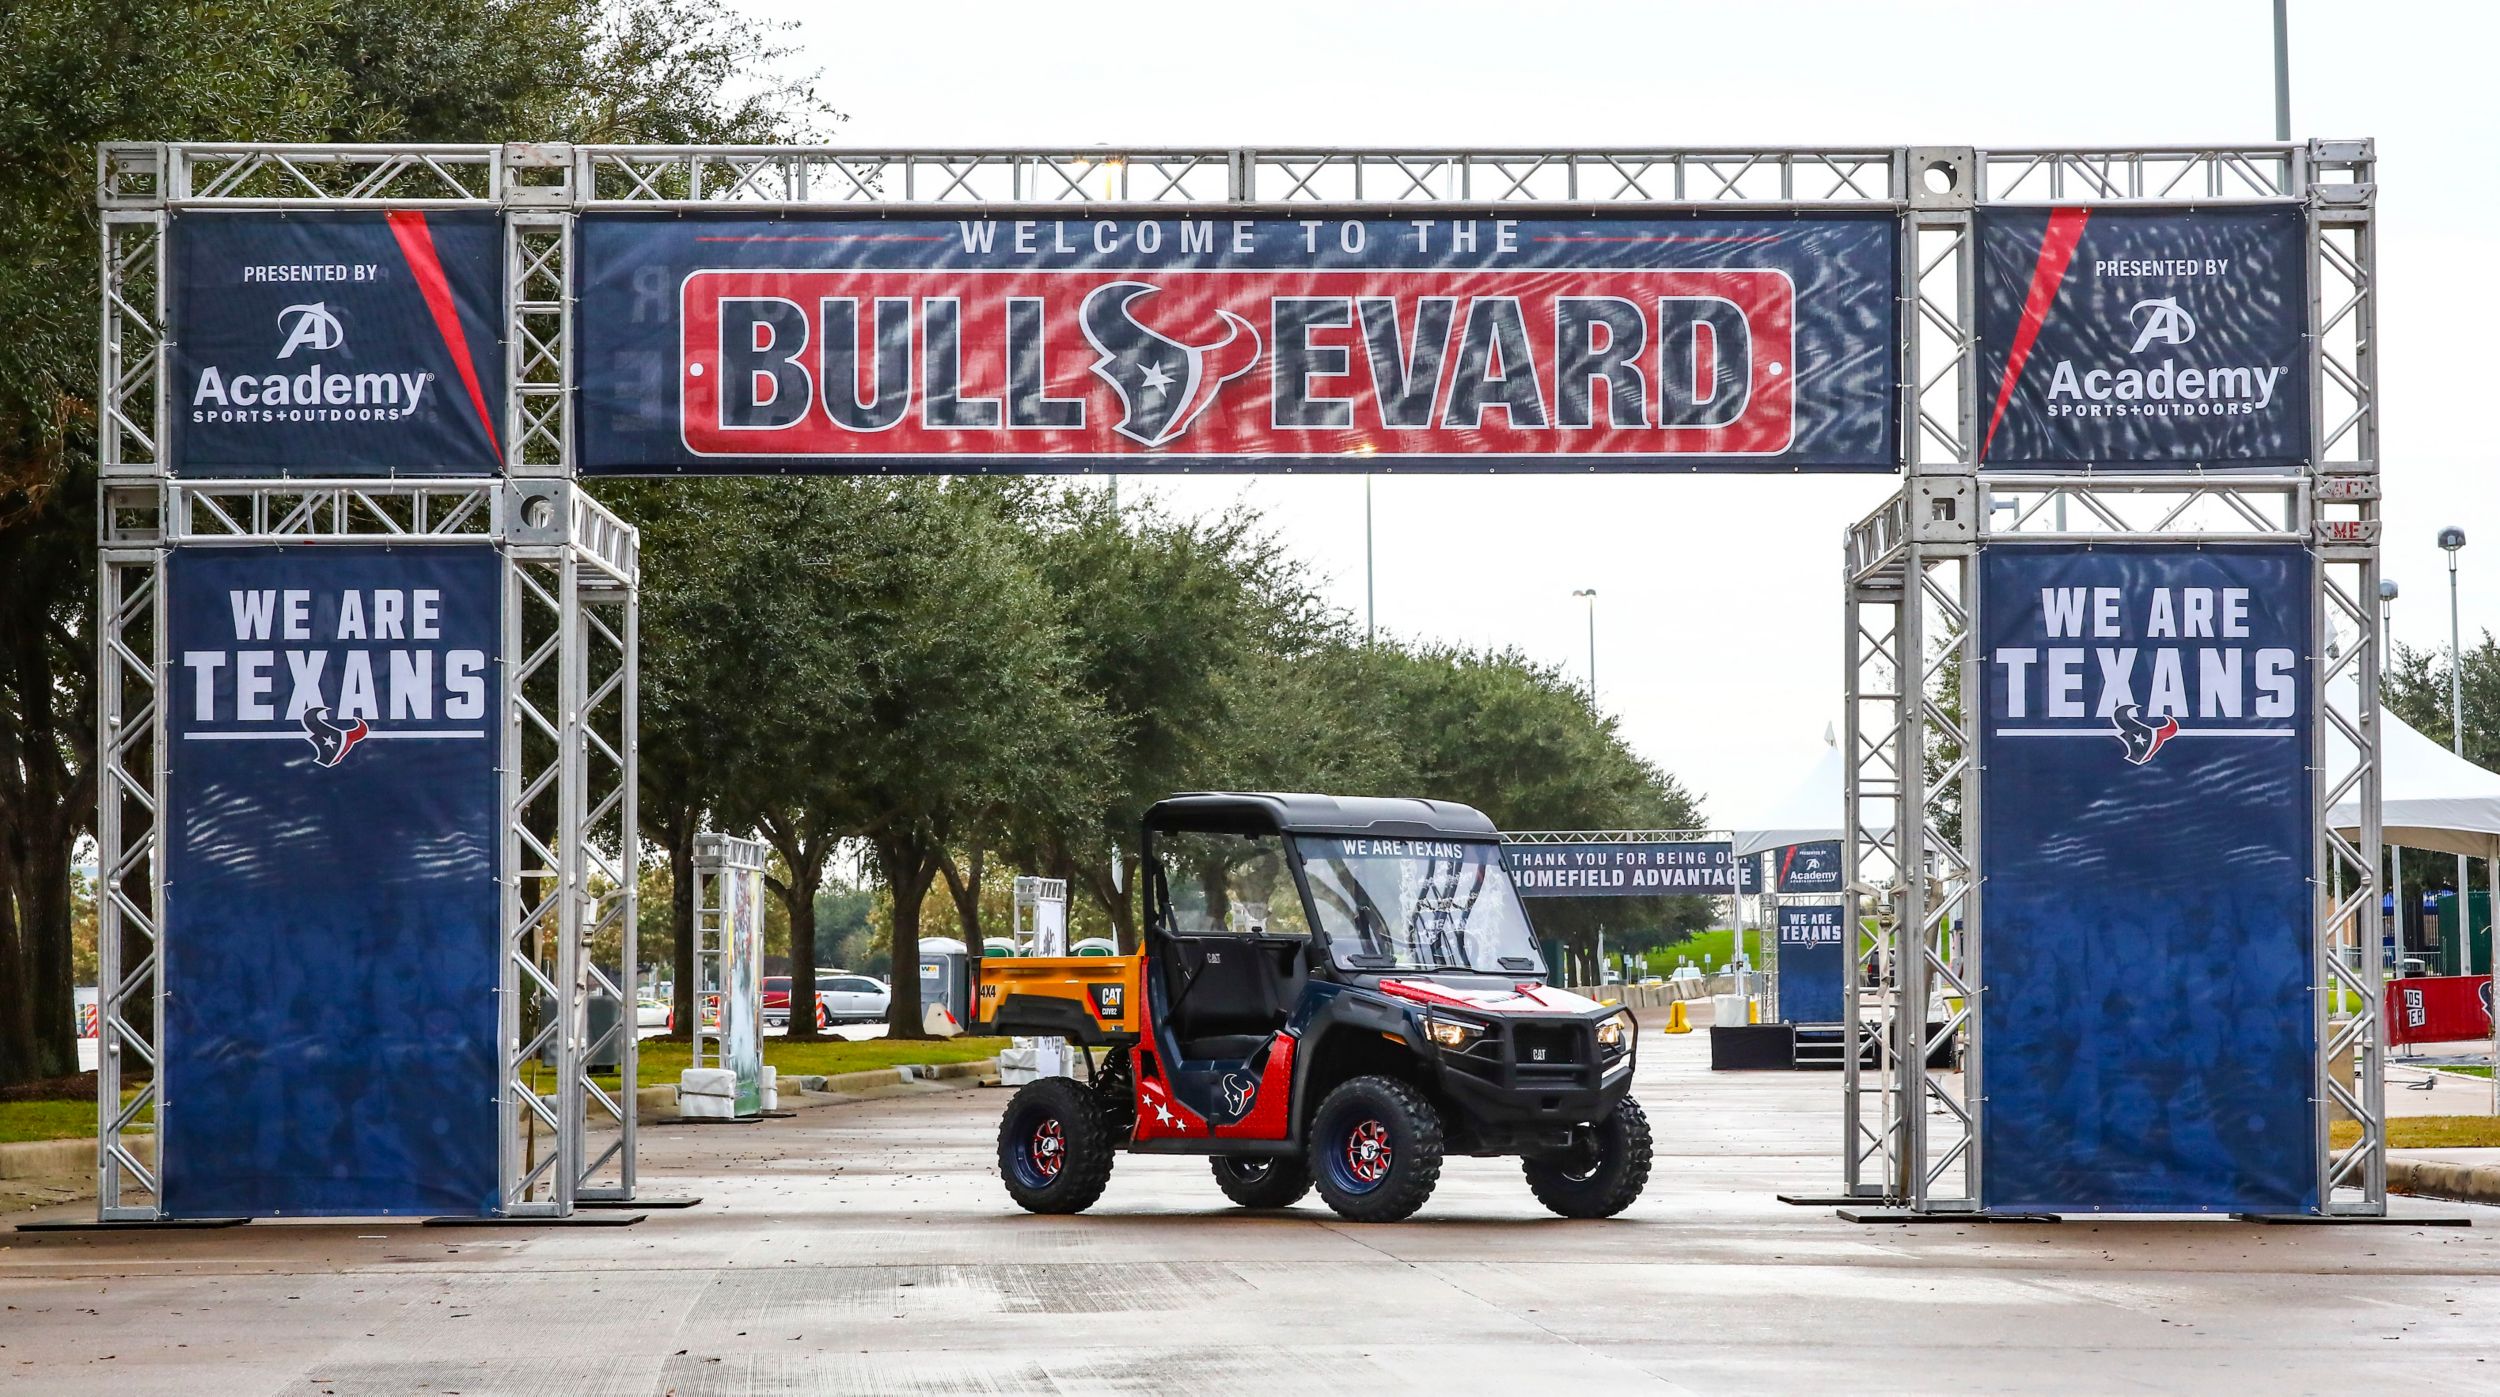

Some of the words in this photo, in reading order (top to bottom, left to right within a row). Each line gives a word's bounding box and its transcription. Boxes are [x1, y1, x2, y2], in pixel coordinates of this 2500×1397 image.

[961, 220, 1254, 254] WELCOME
[1299, 220, 1366, 254] TO
[1412, 220, 1519, 253] THE
[244, 264, 346, 283] PRESENTED
[354, 264, 378, 281] BY
[2095, 259, 2199, 277] PRESENTED
[2205, 258, 2229, 277] BY
[718, 296, 1086, 432] BULL
[1271, 296, 1752, 430] EVARD
[193, 409, 400, 423] SPORTS+OUTDOORS
[2047, 402, 2254, 417] SPORTS+OUTDOORS
[2334, 521, 2361, 539] ME
[229, 589, 311, 640] WE
[338, 589, 441, 640] ARE
[2041, 587, 2121, 638] WE
[2147, 587, 2250, 638] ARE
[184, 650, 485, 721] TEXANS
[1996, 647, 2296, 719] TEXANS
[1342, 839, 1368, 855] WE
[1372, 839, 1402, 856] ARE
[1405, 840, 1463, 859] TEXANS
[1512, 853, 1567, 866] THANK
[1576, 852, 1607, 865] YOU
[1616, 852, 1647, 865] FOR
[1656, 851, 1706, 865] BEING
[1511, 869, 1625, 888] HOMEFIELD
[1632, 868, 1752, 887] ADVANTAGE
[1789, 913, 1807, 925] WE
[1811, 913, 1833, 925] ARE
[1781, 925, 1842, 941] TEXANS
[1102, 987, 1122, 1006] CAT
[1532, 1048, 1546, 1061] CAT
